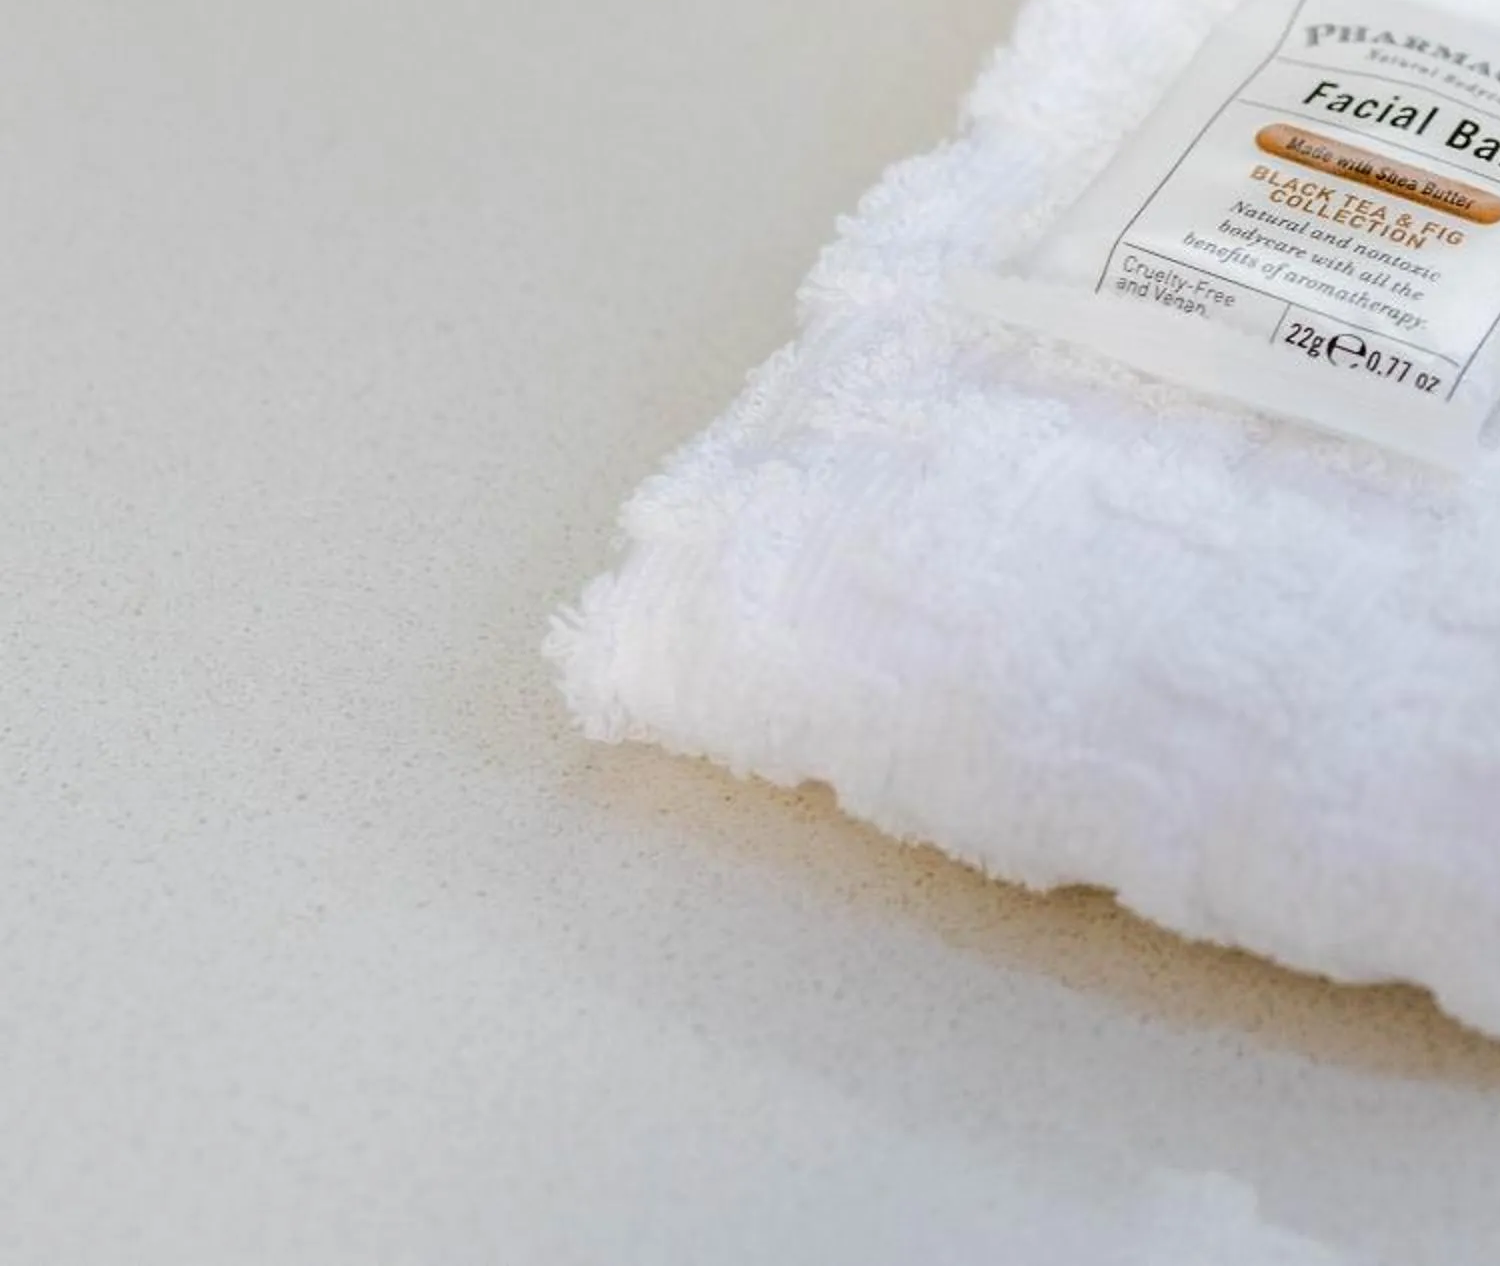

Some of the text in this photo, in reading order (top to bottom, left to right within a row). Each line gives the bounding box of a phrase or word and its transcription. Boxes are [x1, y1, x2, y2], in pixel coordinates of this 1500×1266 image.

[1302, 80, 1439, 136] Facial
[1286, 135, 1330, 163] Made
[1337, 154, 1374, 175] with
[1421, 182, 1474, 211] Butter
[1249, 164, 1466, 247] BLACK TEA & FIG
[1268, 188, 1428, 250] COLLECTION
[1183, 231, 1258, 268] benefits
[1260, 260, 1286, 282] of
[1217, 219, 1426, 302] bodycare with all the
[1229, 200, 1443, 283] Natural and nontoxic
[1116, 276, 1149, 300] and
[1122, 254, 1237, 307] Cruelty-Free
[1414, 371, 1442, 394] oz
